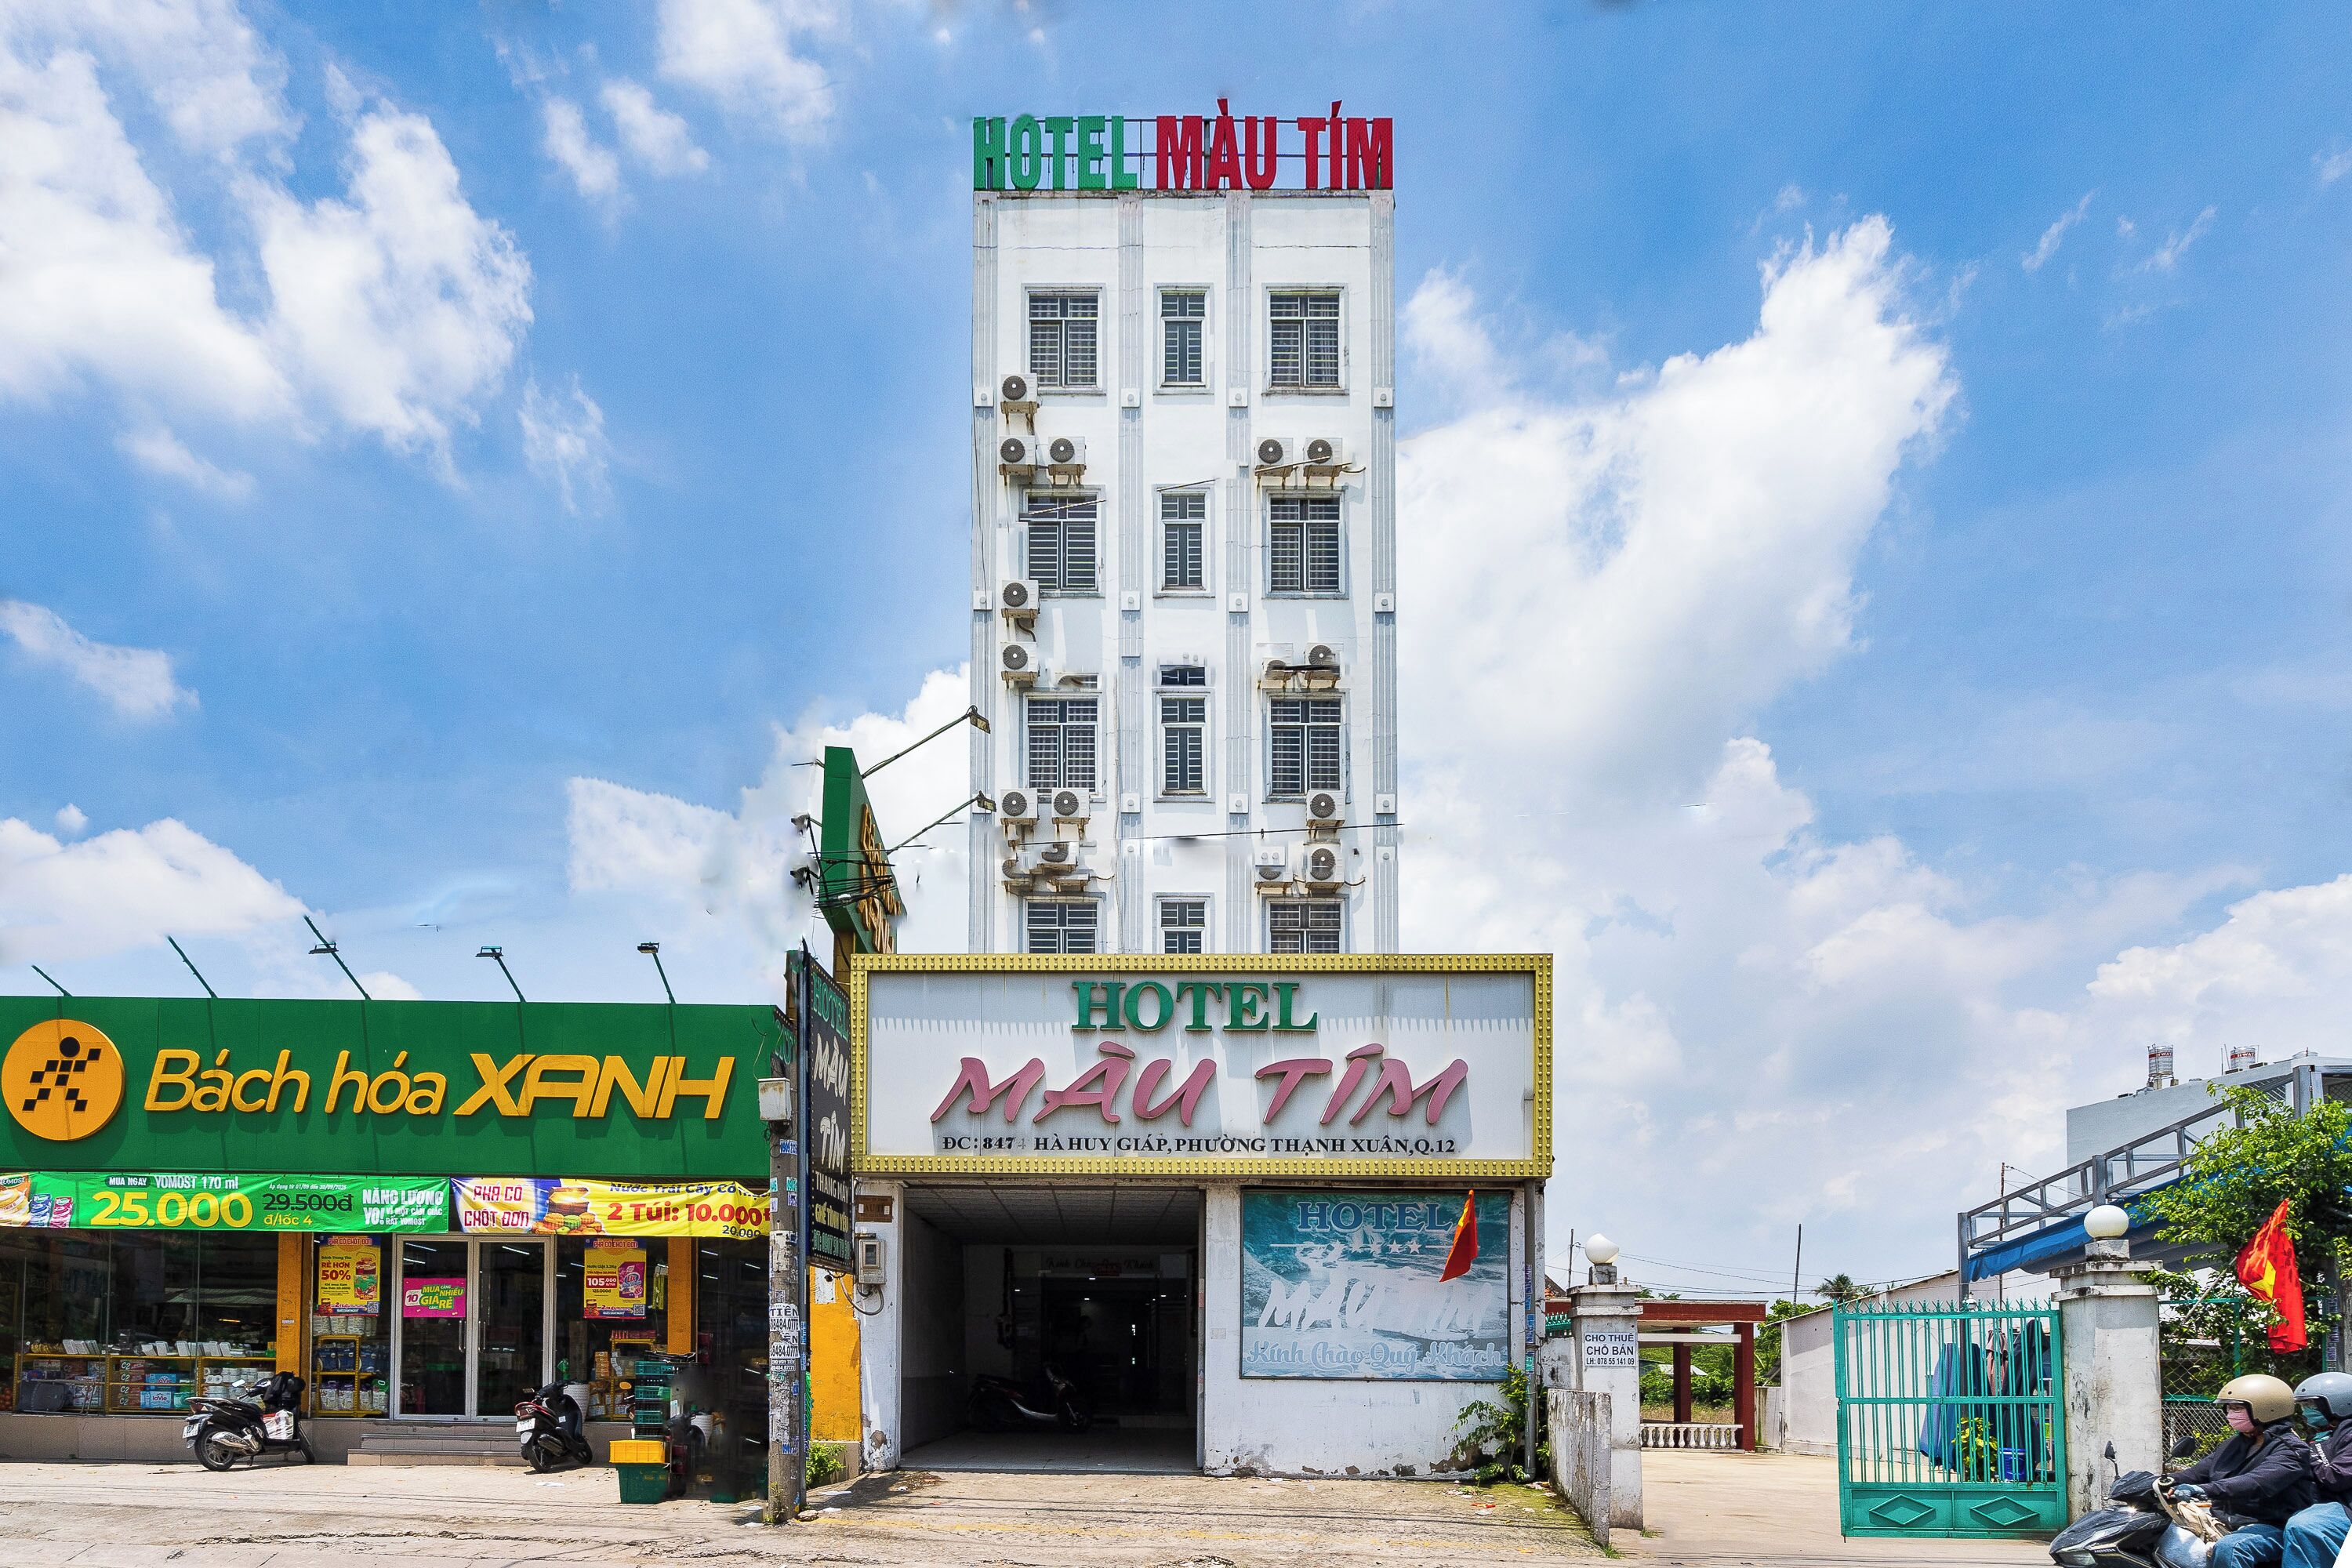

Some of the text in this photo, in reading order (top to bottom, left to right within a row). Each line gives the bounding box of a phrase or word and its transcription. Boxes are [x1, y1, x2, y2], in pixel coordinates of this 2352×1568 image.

[973, 98, 1393, 190] HOTEL MÀU TÍM
[812, 971, 849, 1044] HOTEL
[1071, 980, 1318, 1032] HOTEL
[813, 1033, 849, 1106] MÀU
[144, 1048, 735, 1119] Bách hóa XANH
[930, 1040, 1468, 1127] MÀU TÍM
[819, 1110, 846, 1175] TÍM
[942, 1137, 978, 1149] ĐC:
[1033, 1133, 1065, 1151] HÀ
[1068, 1137, 1112, 1151] HUY
[1116, 1133, 1172, 1155] GIÁP,
[1270, 1138, 1345, 1156] THẠNH
[109, 1176, 239, 1189] MUA NGAY YOMOST 170 ml
[473, 1182, 500, 1201] PHÁ
[685, 1182, 713, 1196] Cây
[815, 1171, 837, 1199] THANG
[262, 1193, 354, 1212] 29.500đ
[362, 1189, 444, 1206] NĂNG LƯỢNG
[90, 1191, 253, 1228] 25.000
[263, 1213, 312, 1226] đ/lốc 4
[363, 1207, 384, 1225] YO!
[608, 1203, 623, 1221] 2
[630, 1201, 680, 1221] Túi:
[1297, 1201, 1453, 1232] HOTEL
[321, 1269, 351, 1280] 50%
[406, 1294, 419, 1302] 10
[420, 1294, 439, 1305] GIÁ
[1608, 1333, 1634, 1341] THUÊ
[1247, 1340, 1308, 1363] Kính
[1311, 1341, 1366, 1374] Chào
[1370, 1341, 1421, 1374] Quý
[1421, 1341, 1505, 1367] Khách
[1612, 1344, 1634, 1355] BÁN
